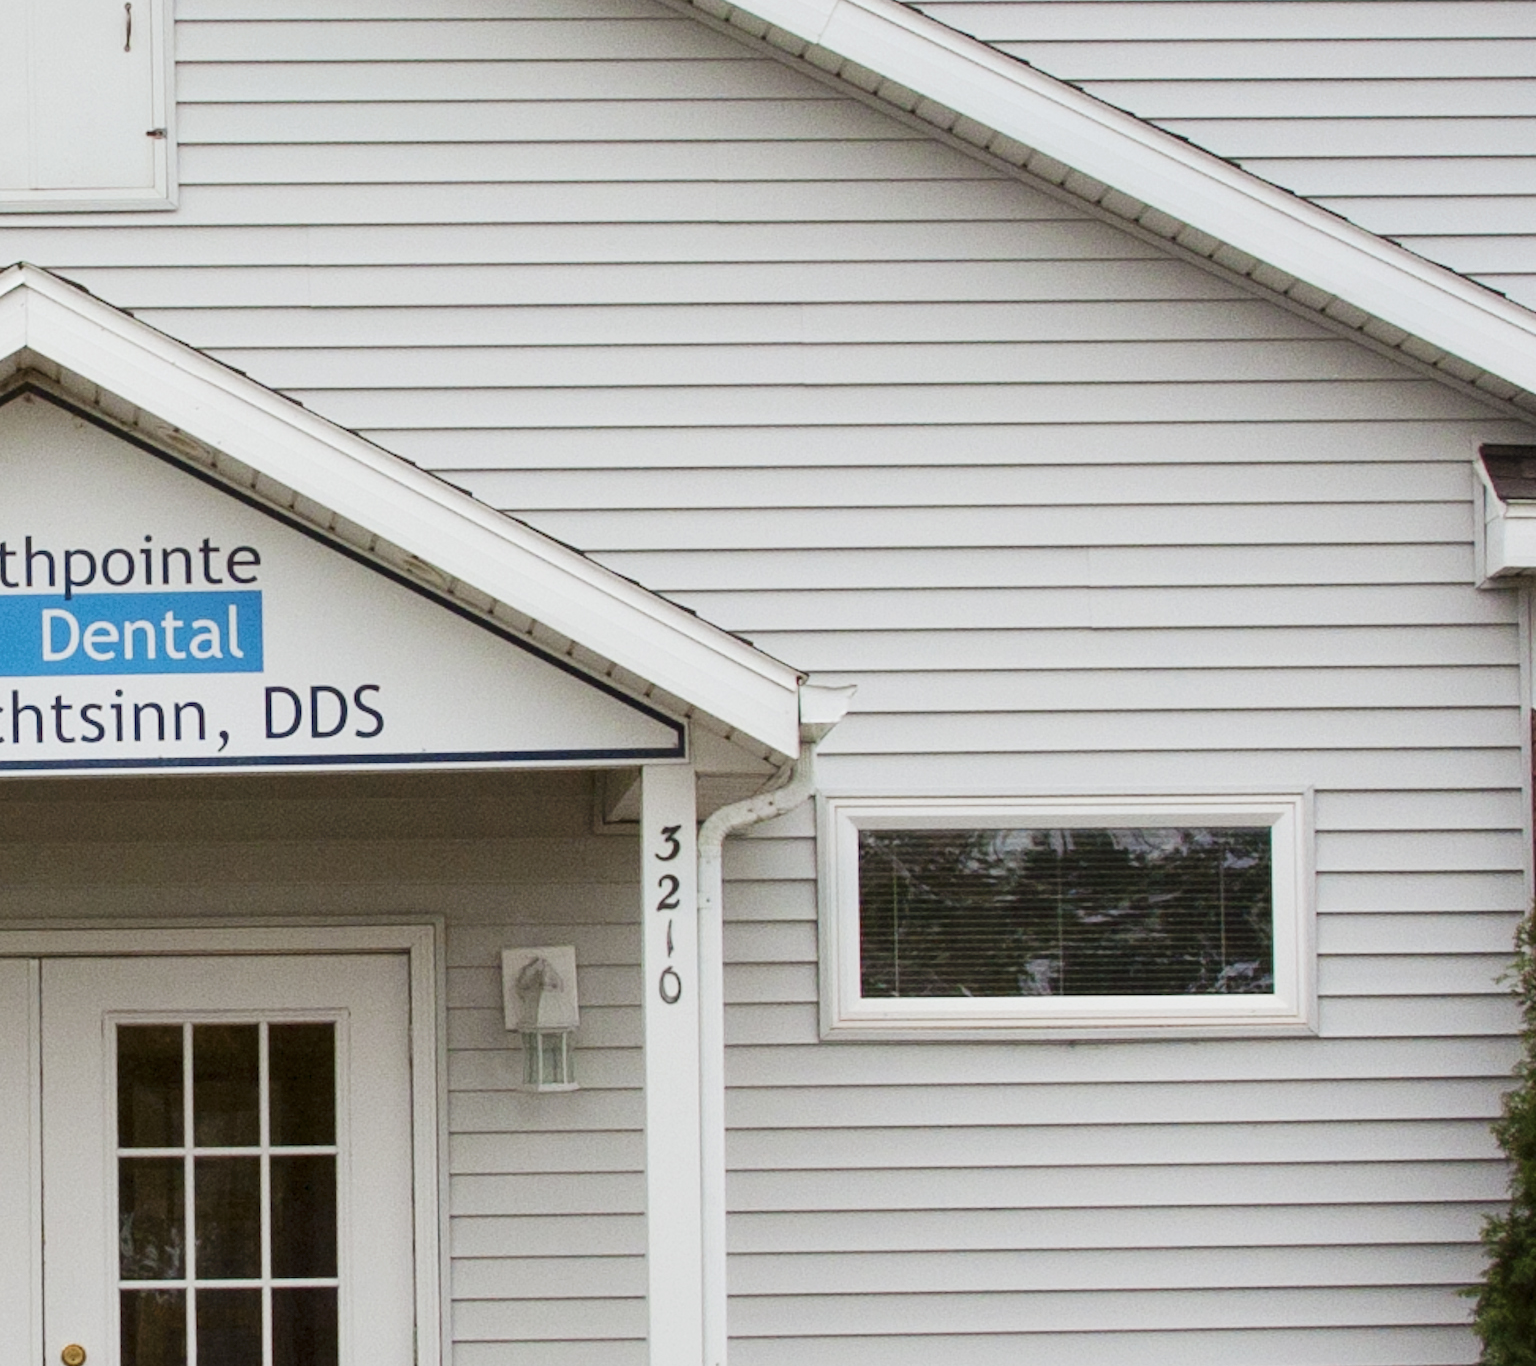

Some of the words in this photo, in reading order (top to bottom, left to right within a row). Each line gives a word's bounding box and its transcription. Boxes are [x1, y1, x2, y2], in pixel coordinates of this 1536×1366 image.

[41, 604, 245, 663] Dental
[263, 684, 386, 740] DDS
[654, 824, 682, 1005] 3210
